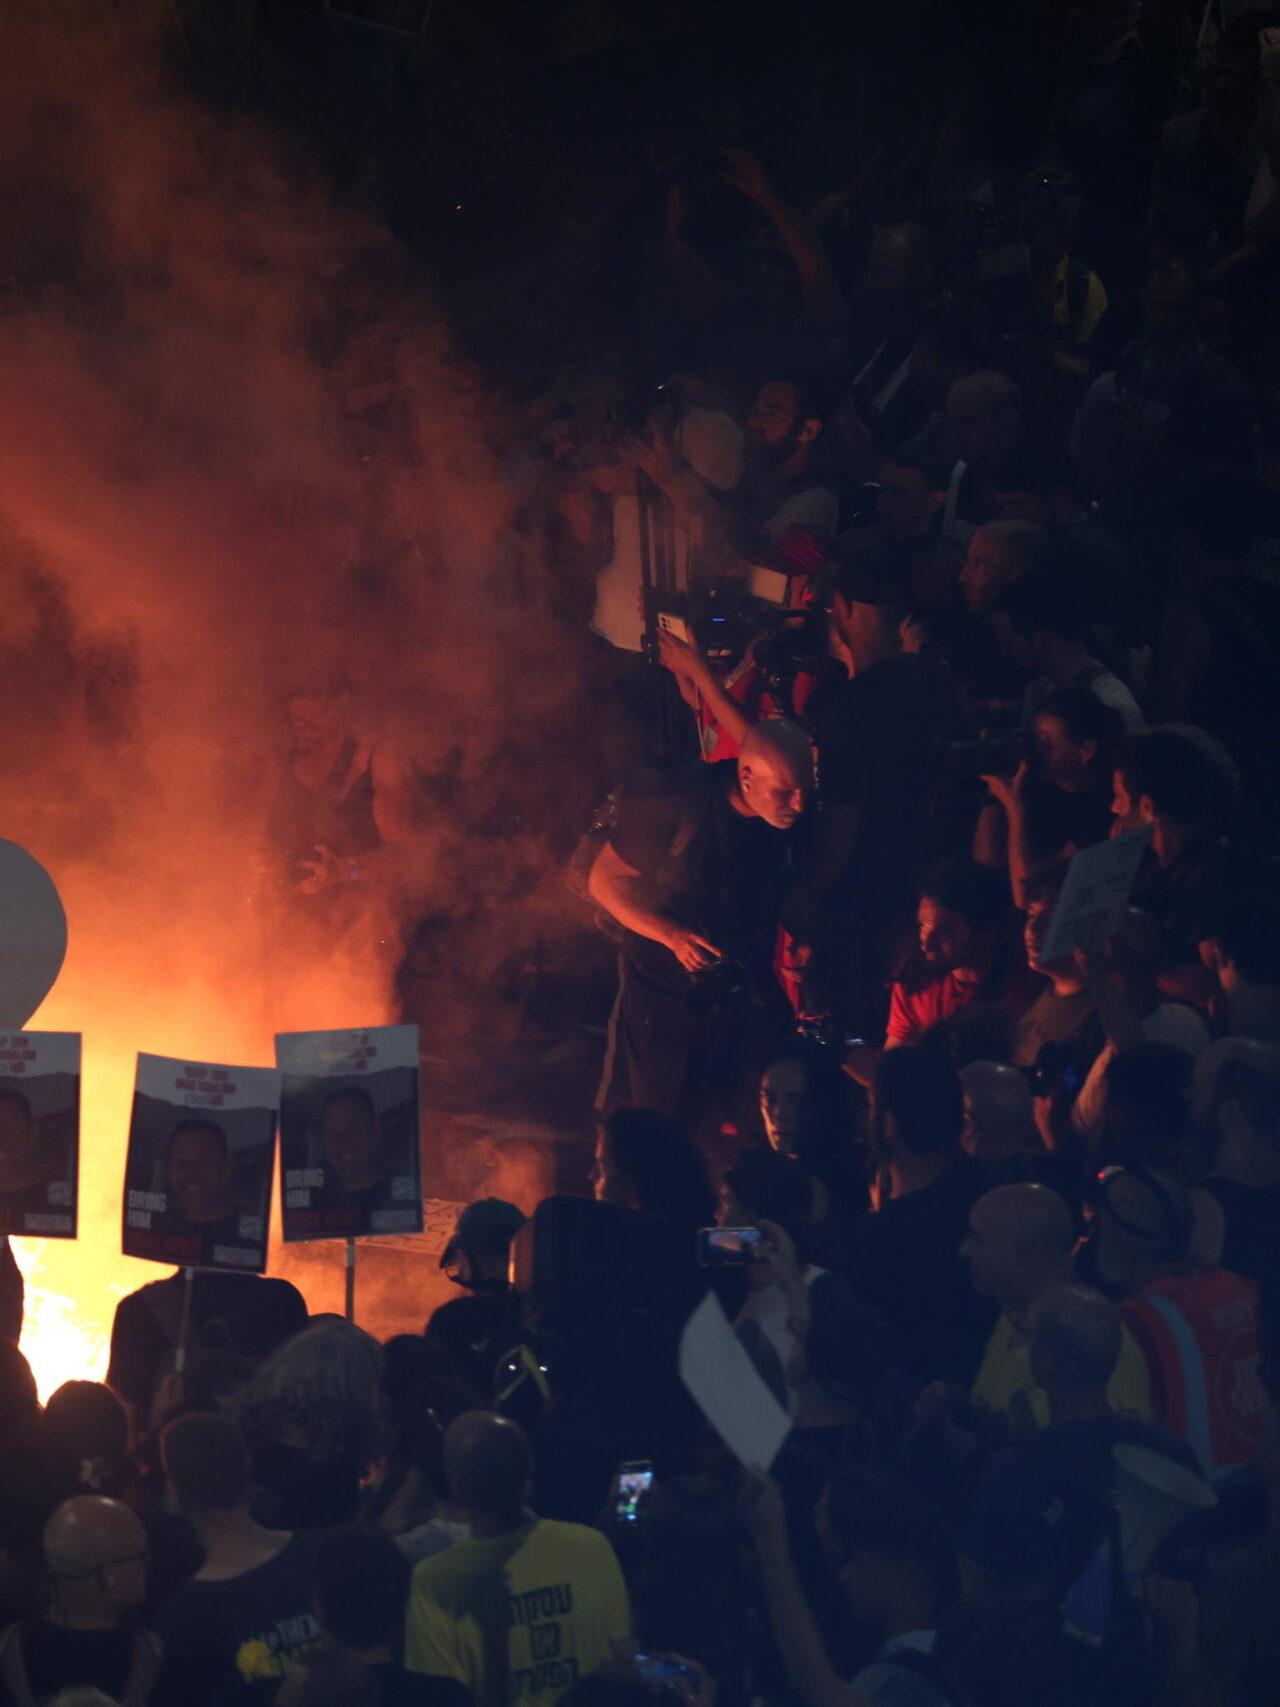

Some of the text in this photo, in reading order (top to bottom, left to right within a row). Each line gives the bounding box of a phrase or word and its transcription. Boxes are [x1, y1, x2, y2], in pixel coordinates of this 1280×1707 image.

[285, 1168, 325, 1189] BRING
[127, 1189, 167, 1213] BRING
[285, 1188, 311, 1208] HIM
[126, 1210, 152, 1230] HIM
